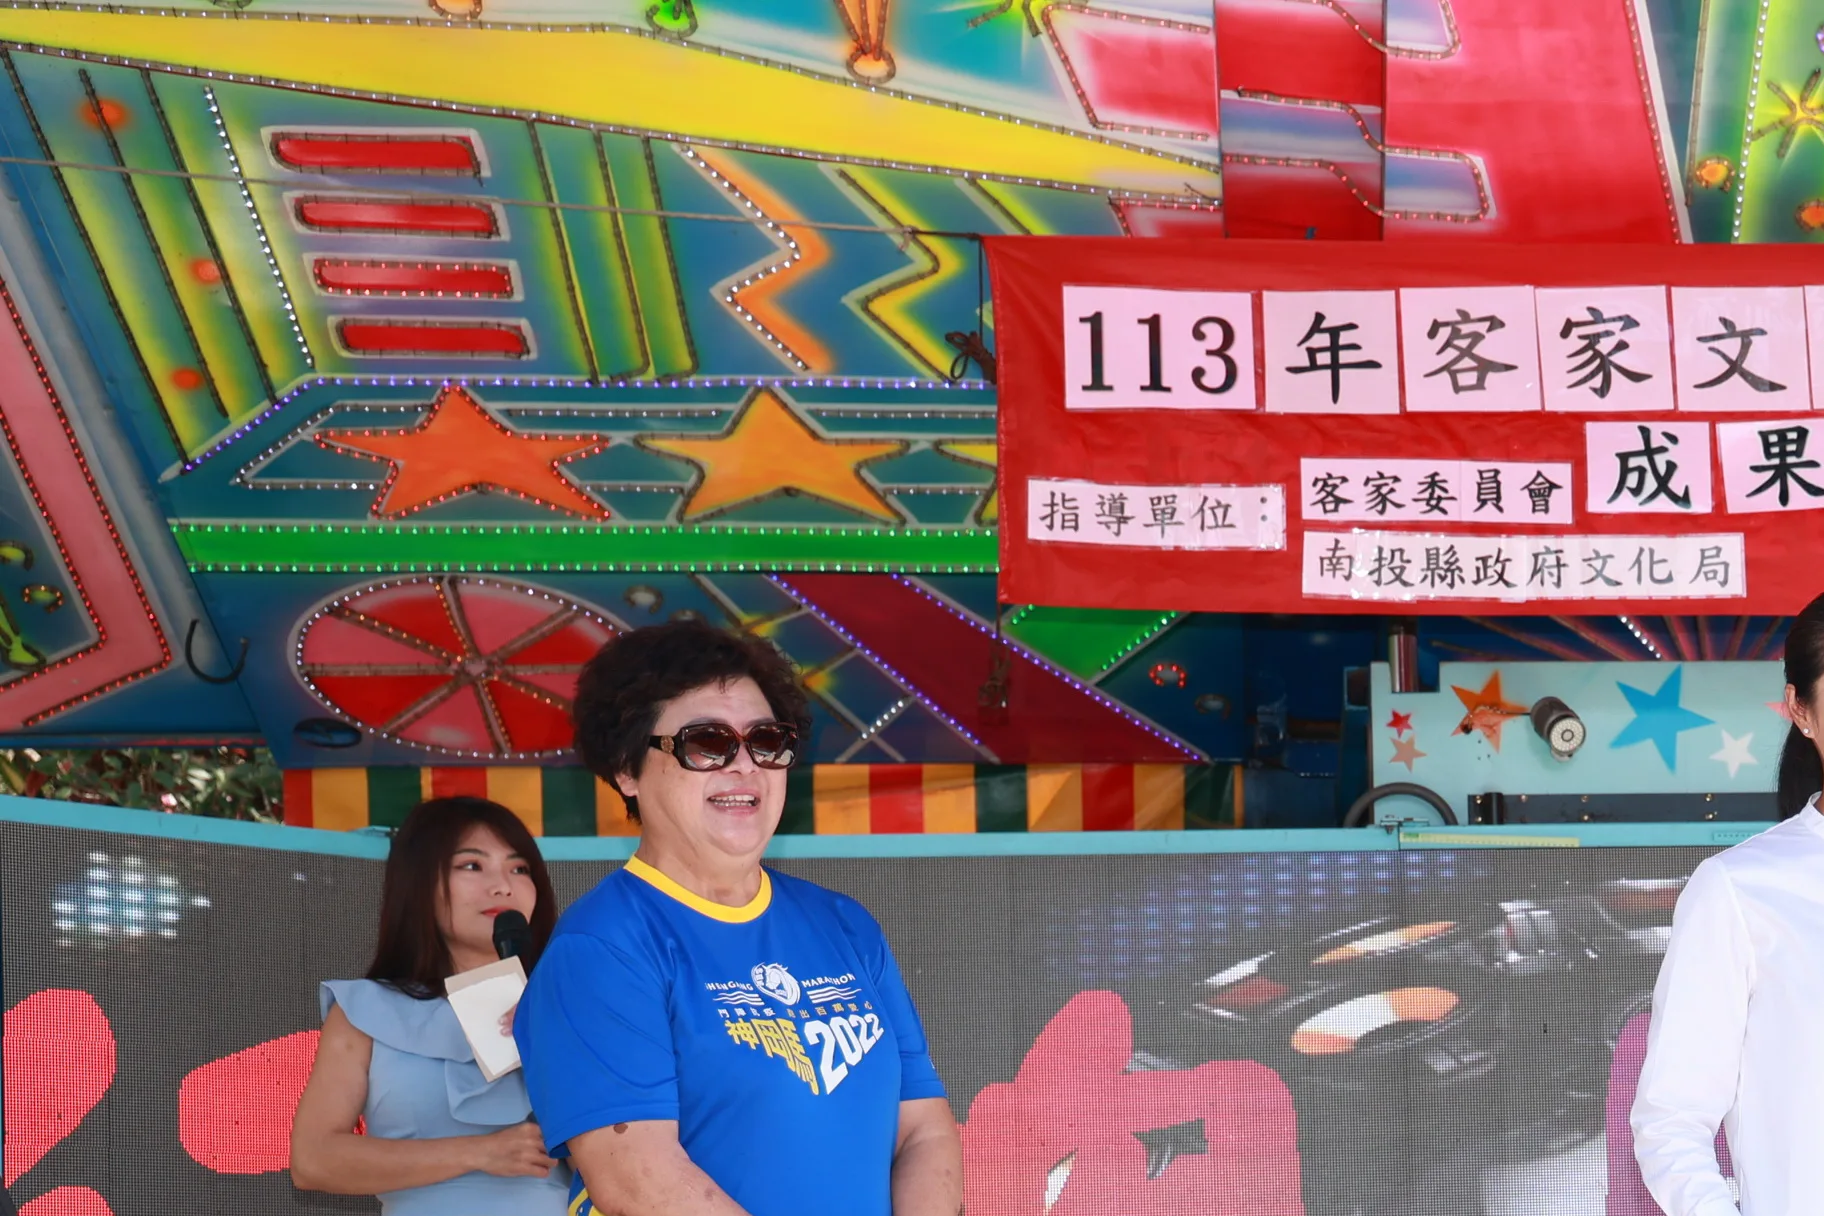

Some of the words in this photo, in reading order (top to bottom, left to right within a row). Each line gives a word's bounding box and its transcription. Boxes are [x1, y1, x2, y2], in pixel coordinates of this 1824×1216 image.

[1310, 468, 1564, 516] 客家委員會
[1318, 538, 1730, 590] 南投縣政府文化局
[803, 1013, 884, 1095] 2022
